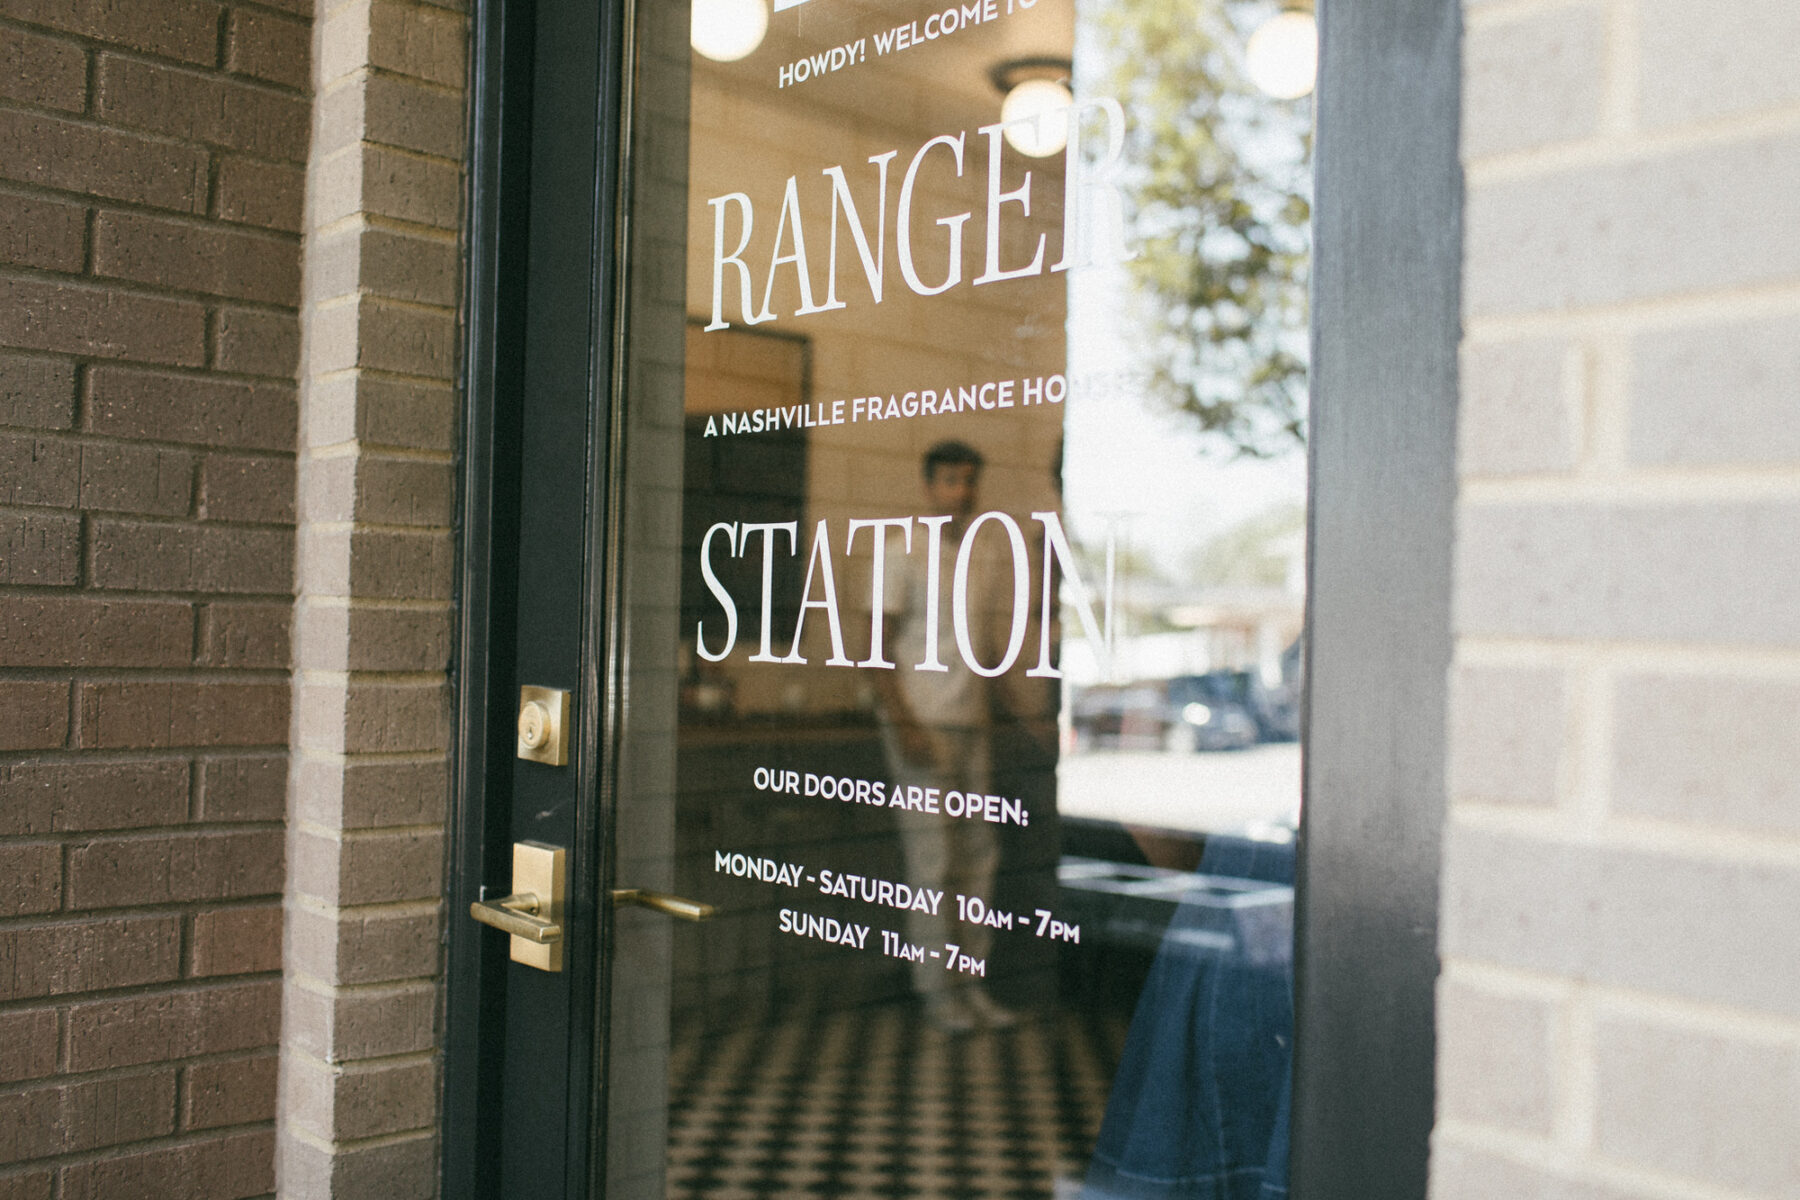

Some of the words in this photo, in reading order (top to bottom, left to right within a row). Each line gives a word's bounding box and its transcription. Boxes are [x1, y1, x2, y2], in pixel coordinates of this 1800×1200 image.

[779, 38, 867, 89] HOWDY!
[873, 0, 999, 56] WELCOME
[703, 96, 1137, 333] RANGER
[703, 415, 719, 438] A
[722, 399, 846, 437] NASHVILLE
[852, 380, 1016, 423] FRAGRANCE
[696, 511, 1128, 681] STATION
[753, 767, 800, 796] OUR
[804, 773, 887, 808] DOORS
[888, 784, 941, 815] ARE
[944, 790, 1030, 828] OPEN:
[715, 850, 805, 889] MONDAY
[819, 869, 944, 916] SATURDAY
[956, 894, 1013, 931] 10AM
[1034, 909, 1081, 945] 7PM
[779, 908, 871, 950] SUNDAY
[881, 930, 926, 965] 11AM
[945, 943, 986, 978] 7PM
